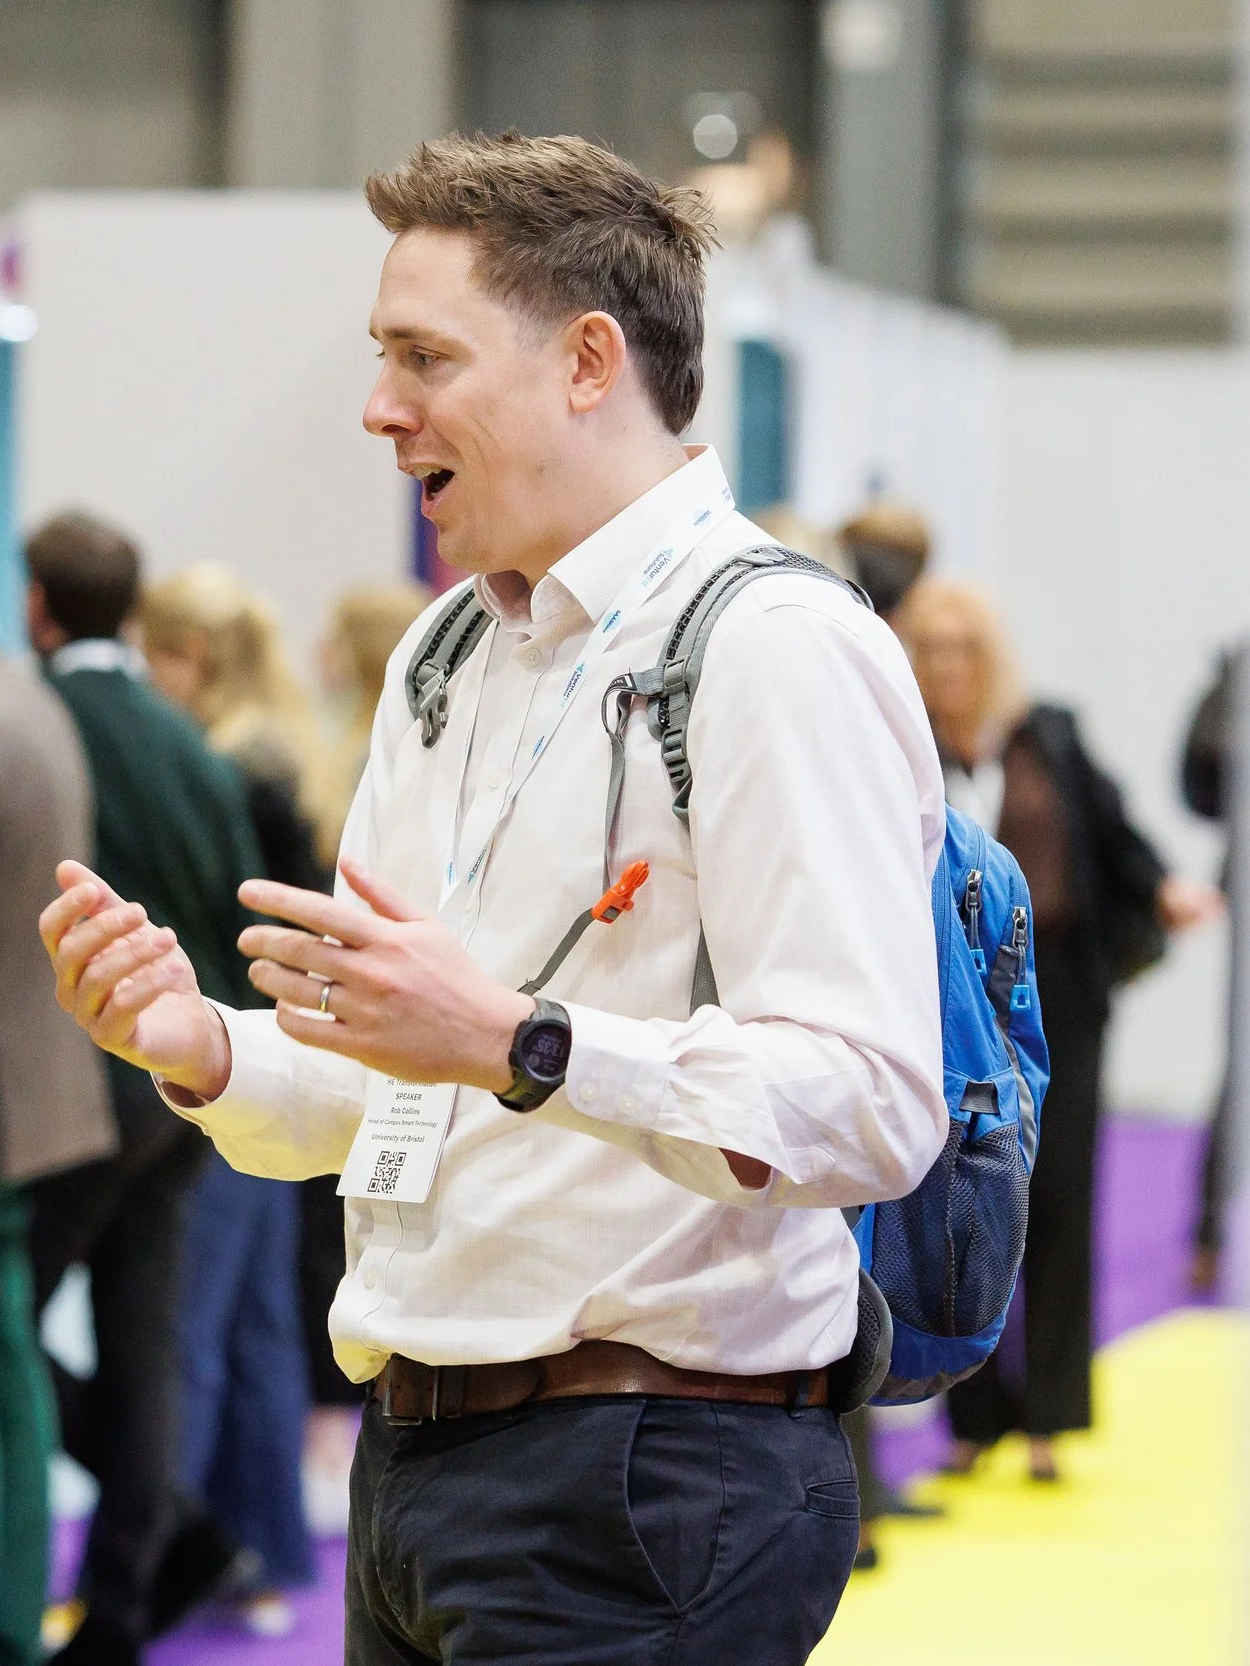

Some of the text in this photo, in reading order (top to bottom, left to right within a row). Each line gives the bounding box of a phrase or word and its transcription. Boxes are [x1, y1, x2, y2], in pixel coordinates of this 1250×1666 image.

[395, 1092, 422, 1101] SPEAKER
[390, 1106, 420, 1115] Rob Collins
[415, 1120, 438, 1128] Technology
[371, 1133, 399, 1143] University
[407, 1135, 425, 1143] Bristol
